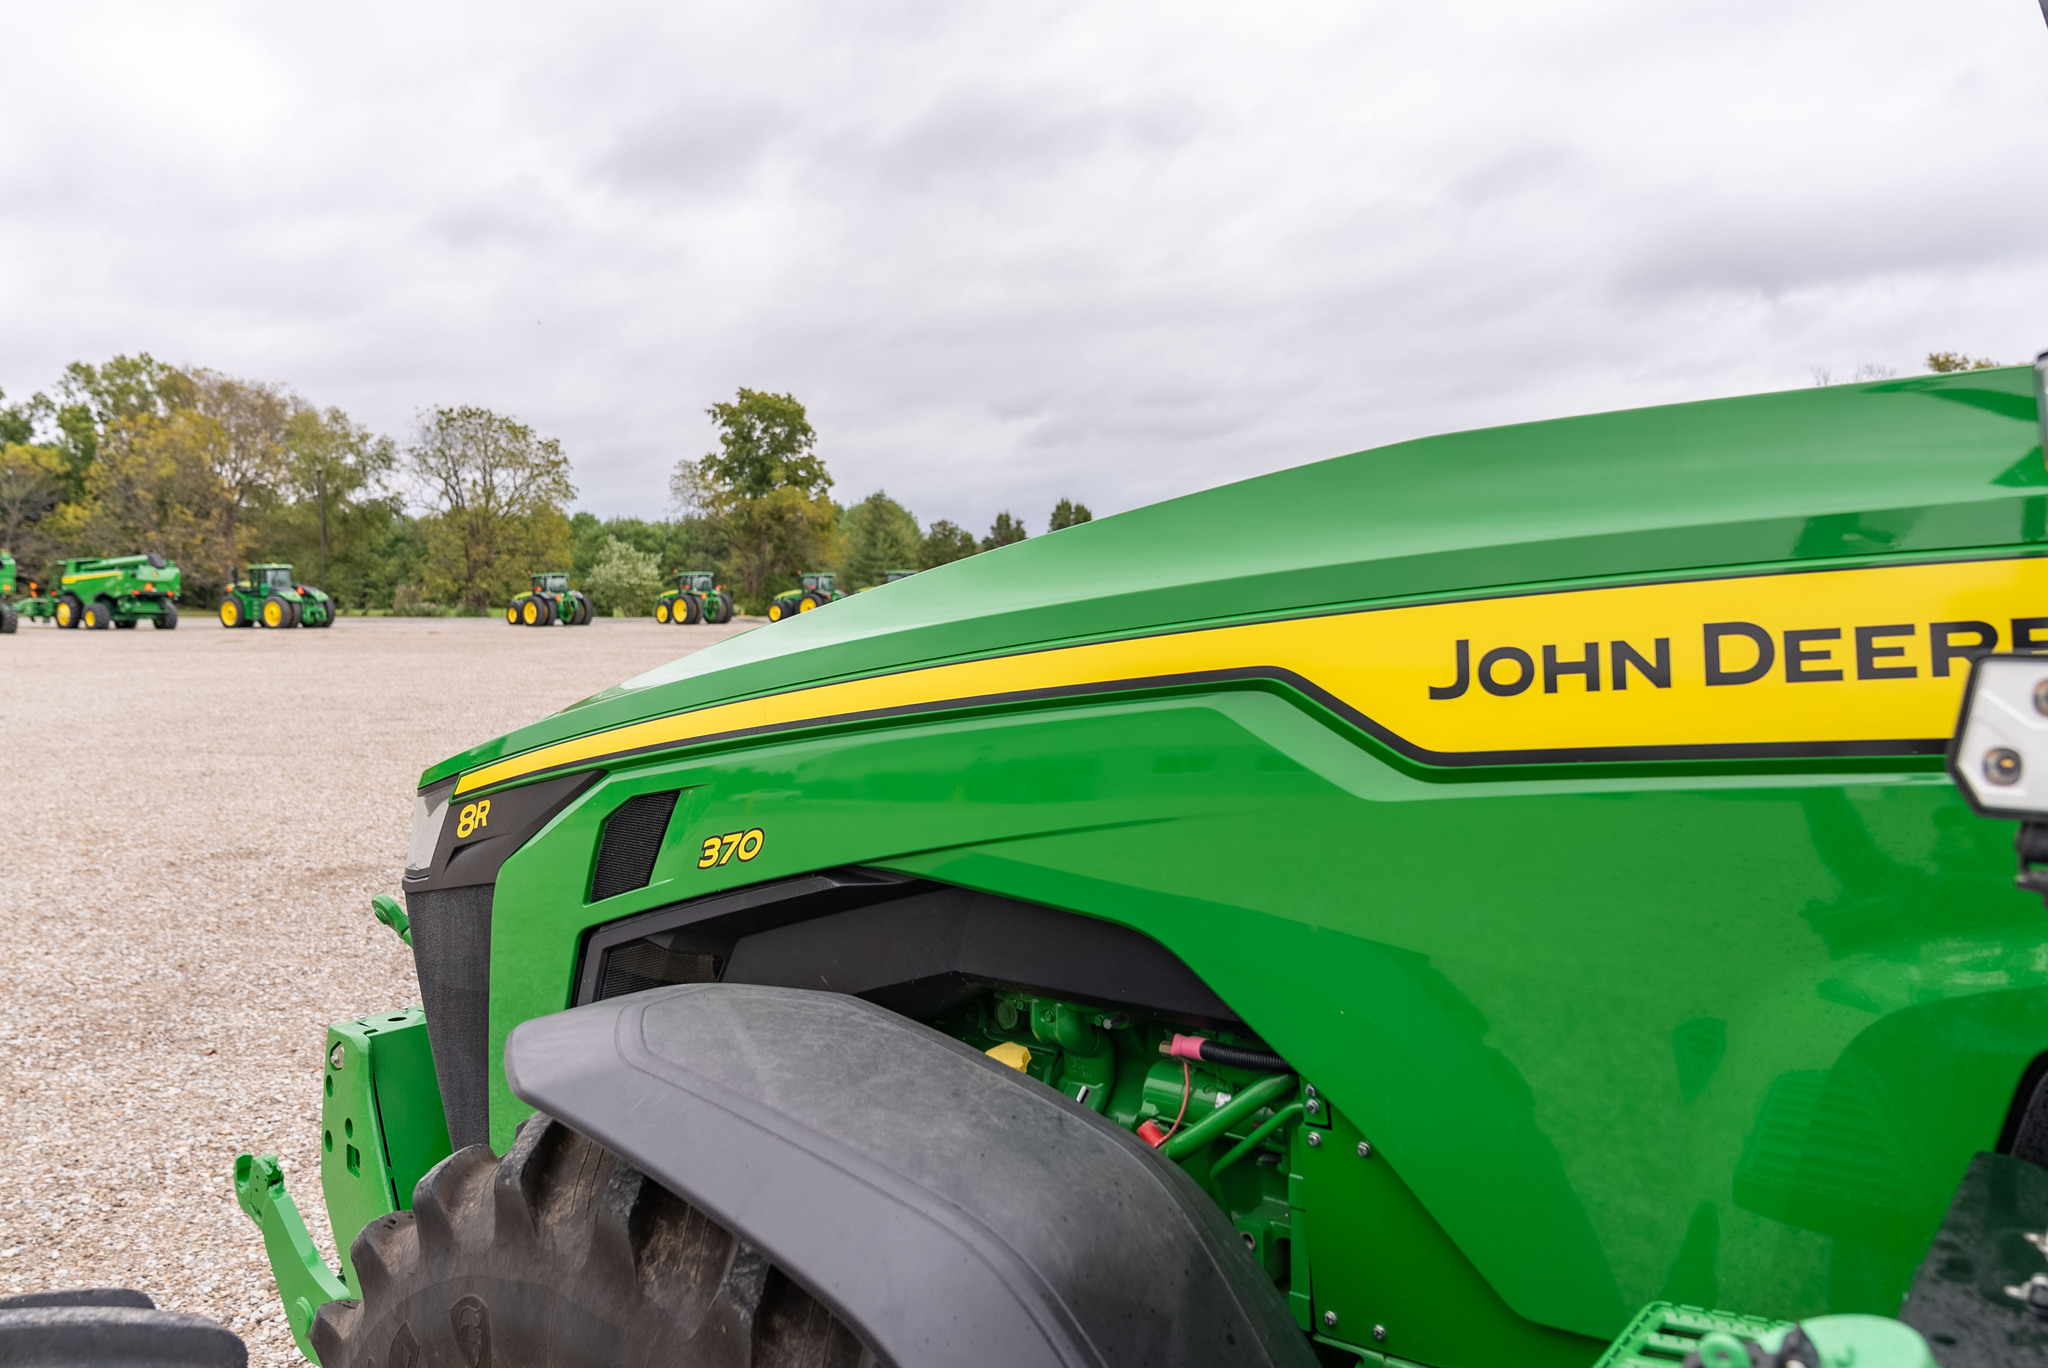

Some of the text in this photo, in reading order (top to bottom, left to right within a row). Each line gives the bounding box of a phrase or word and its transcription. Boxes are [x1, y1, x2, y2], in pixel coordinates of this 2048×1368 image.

[1428, 637, 1672, 701] JOHN
[457, 799, 491, 839] 8R
[697, 826, 765, 870] 370
